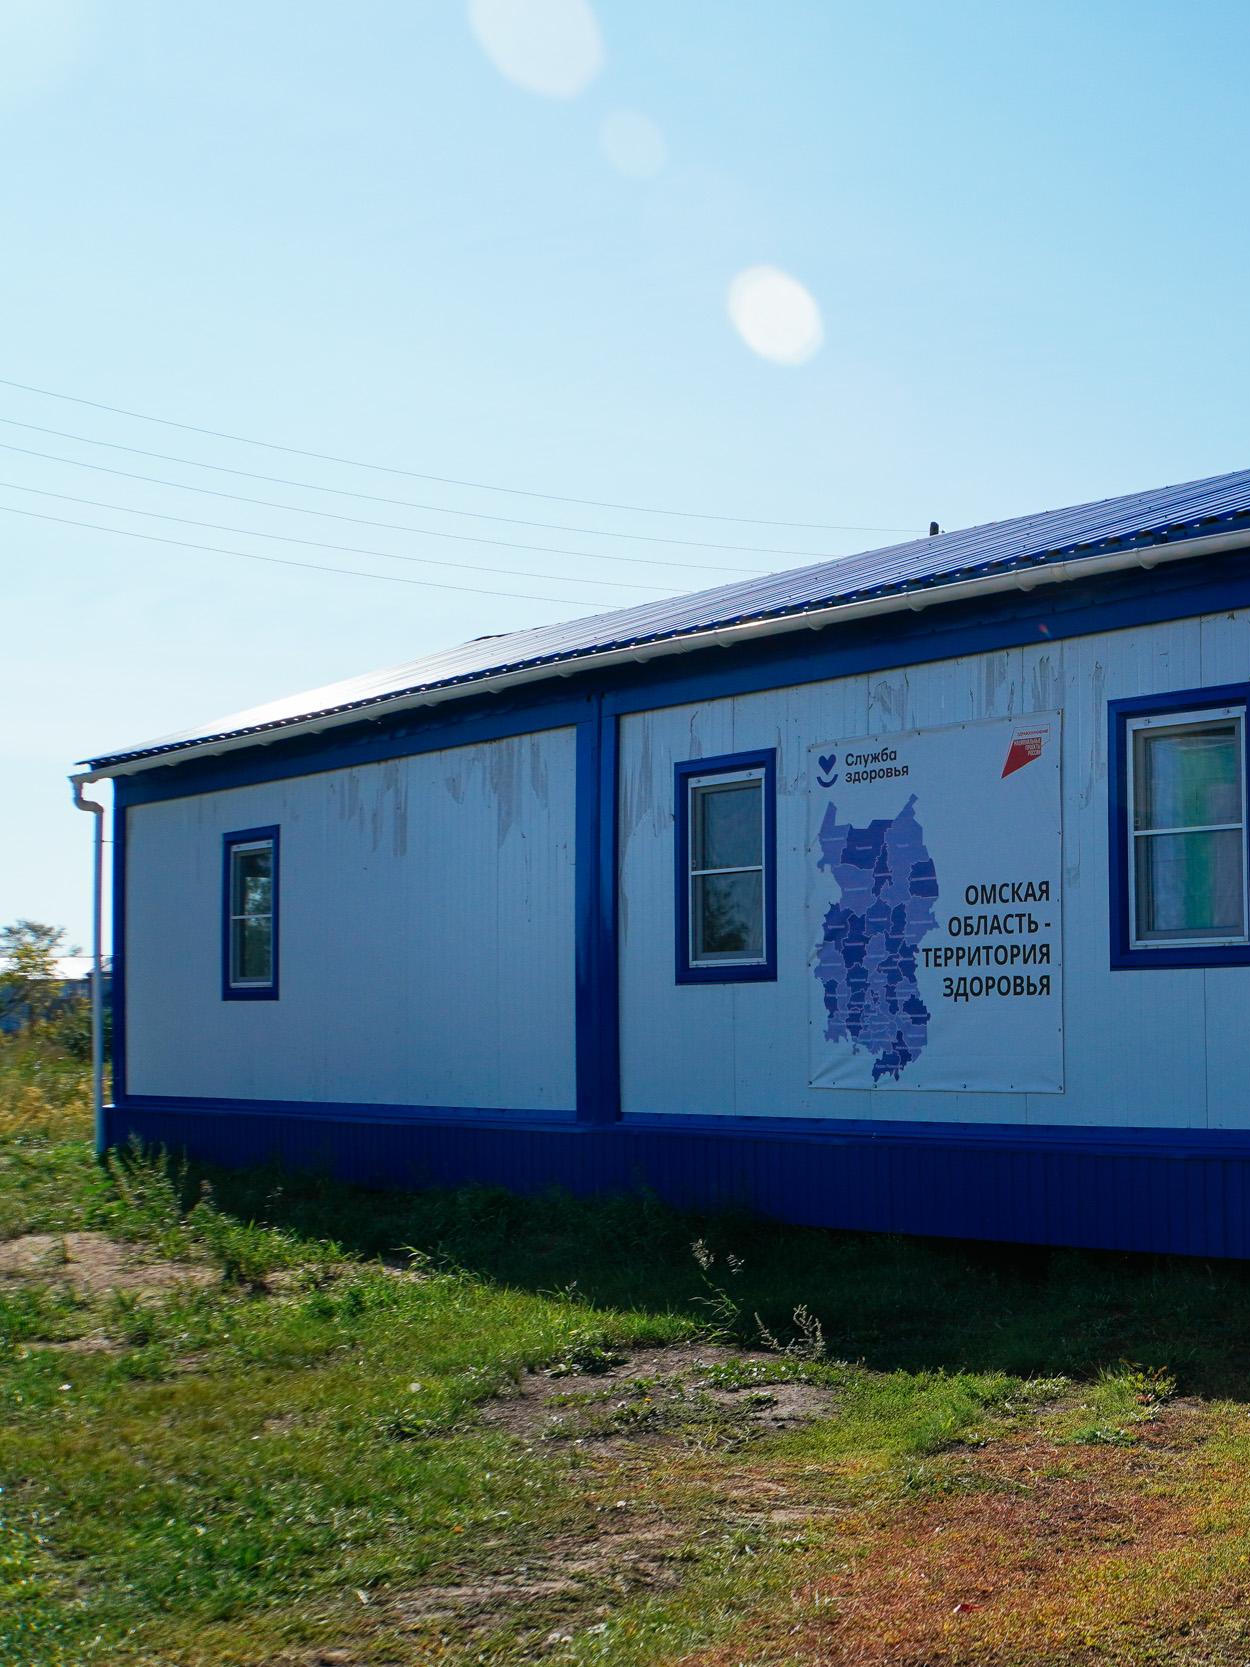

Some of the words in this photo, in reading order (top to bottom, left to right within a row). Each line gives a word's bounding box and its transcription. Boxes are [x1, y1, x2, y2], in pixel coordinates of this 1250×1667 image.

[845, 747, 897, 768] Служба
[845, 765, 909, 784] здоровья
[965, 880, 1050, 906] ОМСКАЯ
[947, 913, 1039, 937] ОБЛАСТЬ
[921, 943, 1051, 968] ТЕРРИТОРИЯ
[942, 975, 1051, 1003] ЗДОРОВЬЯ
